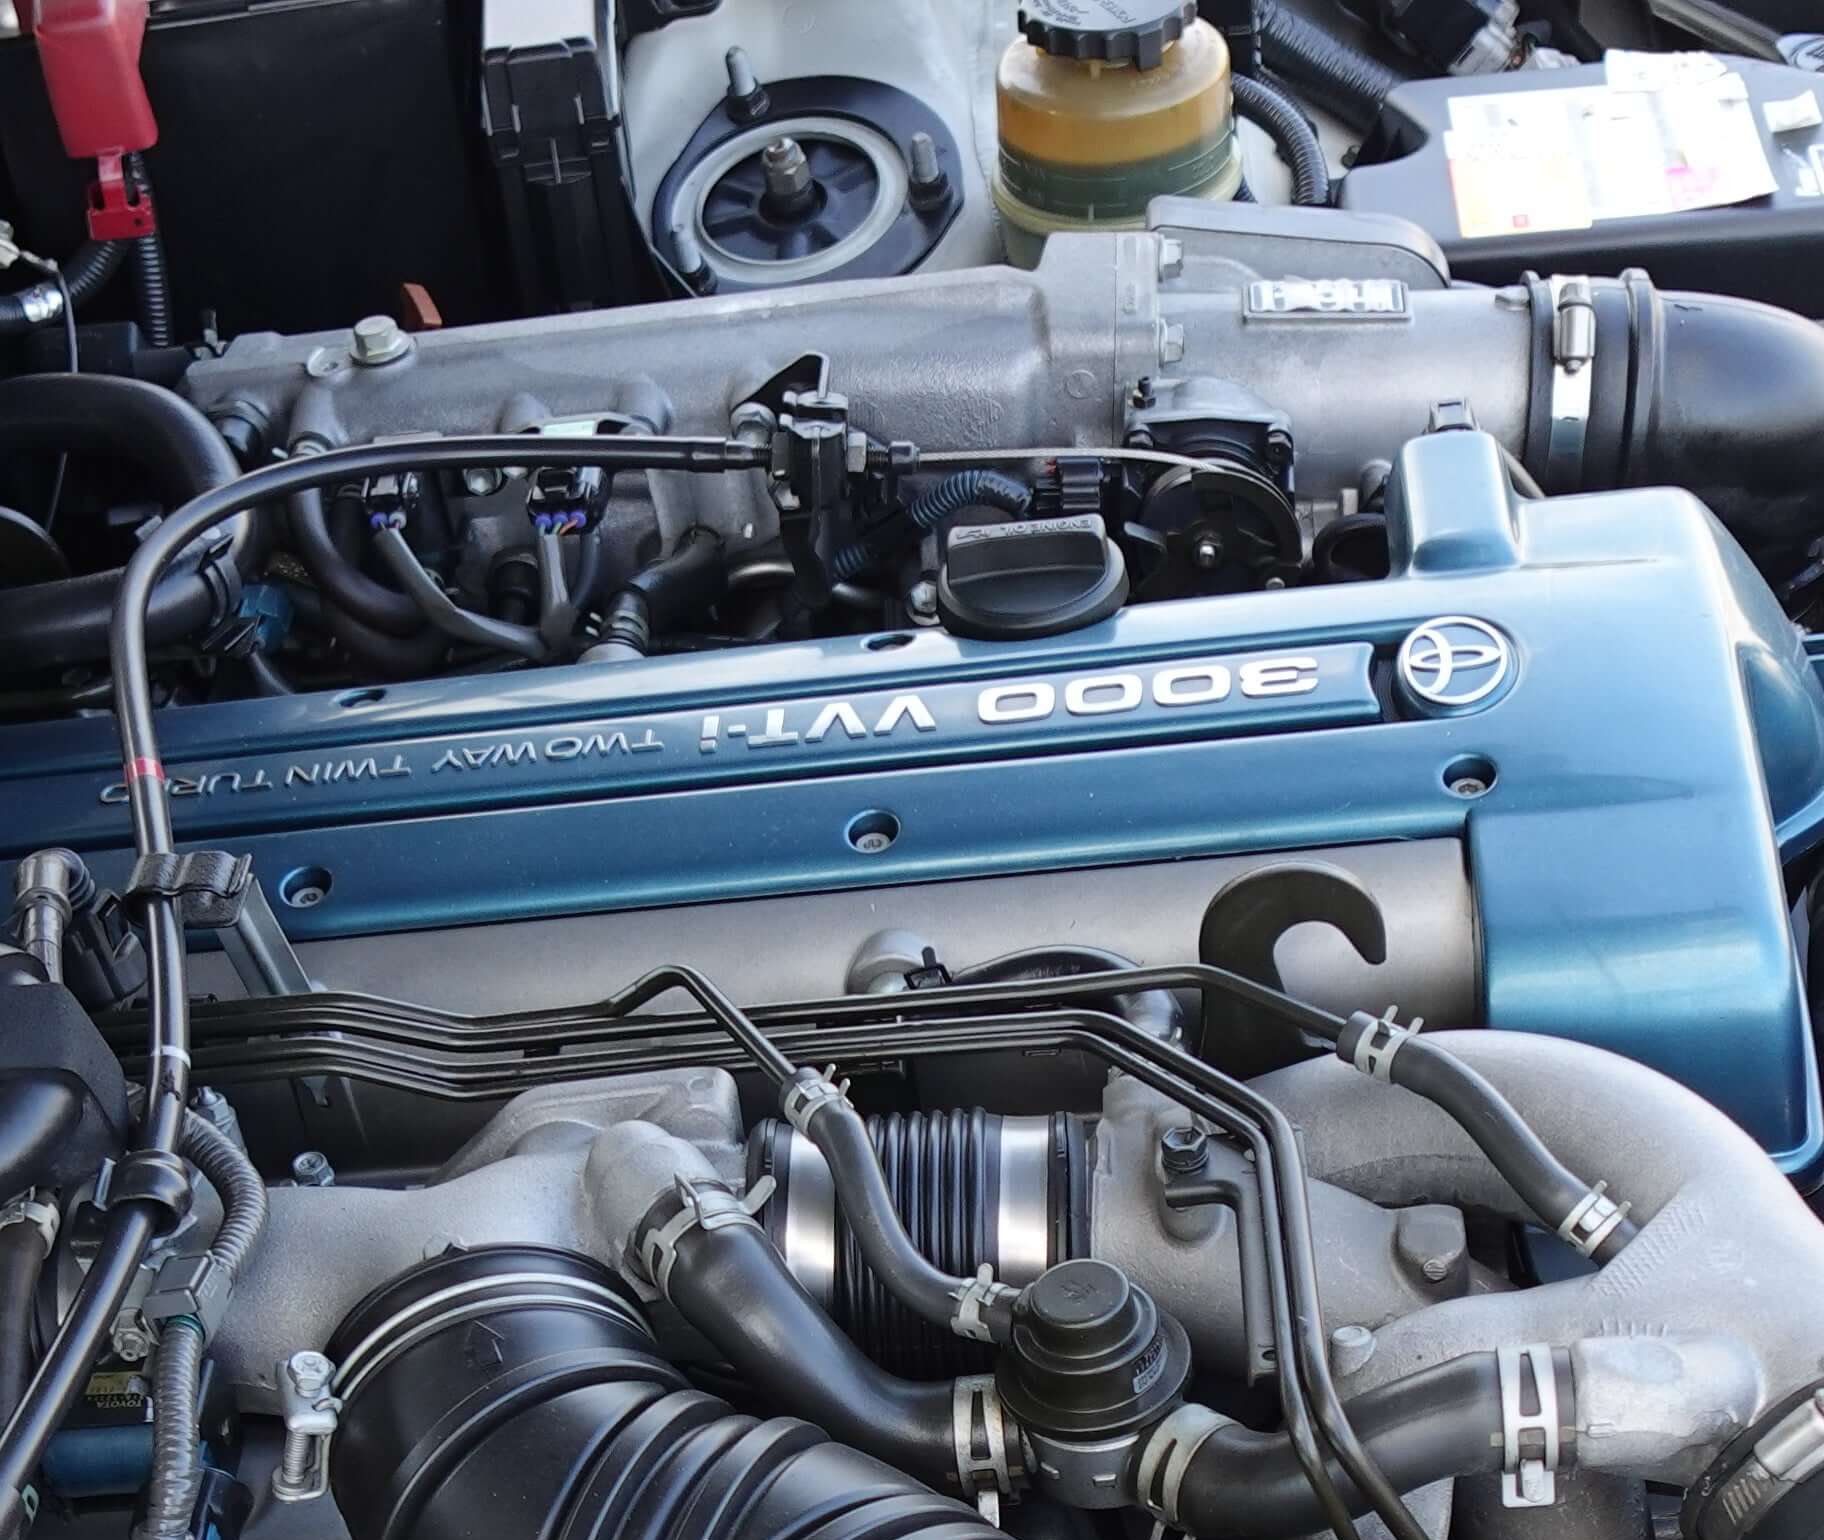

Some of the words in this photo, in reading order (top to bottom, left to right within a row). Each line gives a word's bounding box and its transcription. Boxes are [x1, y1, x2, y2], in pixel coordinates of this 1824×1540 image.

[977, 655, 1320, 723] 3000
[697, 691, 938, 752] VVT-i
[99, 769, 272, 803] TURO
[285, 752, 411, 786] TWIN
[96, 1399, 143, 1409] TOYOTA
